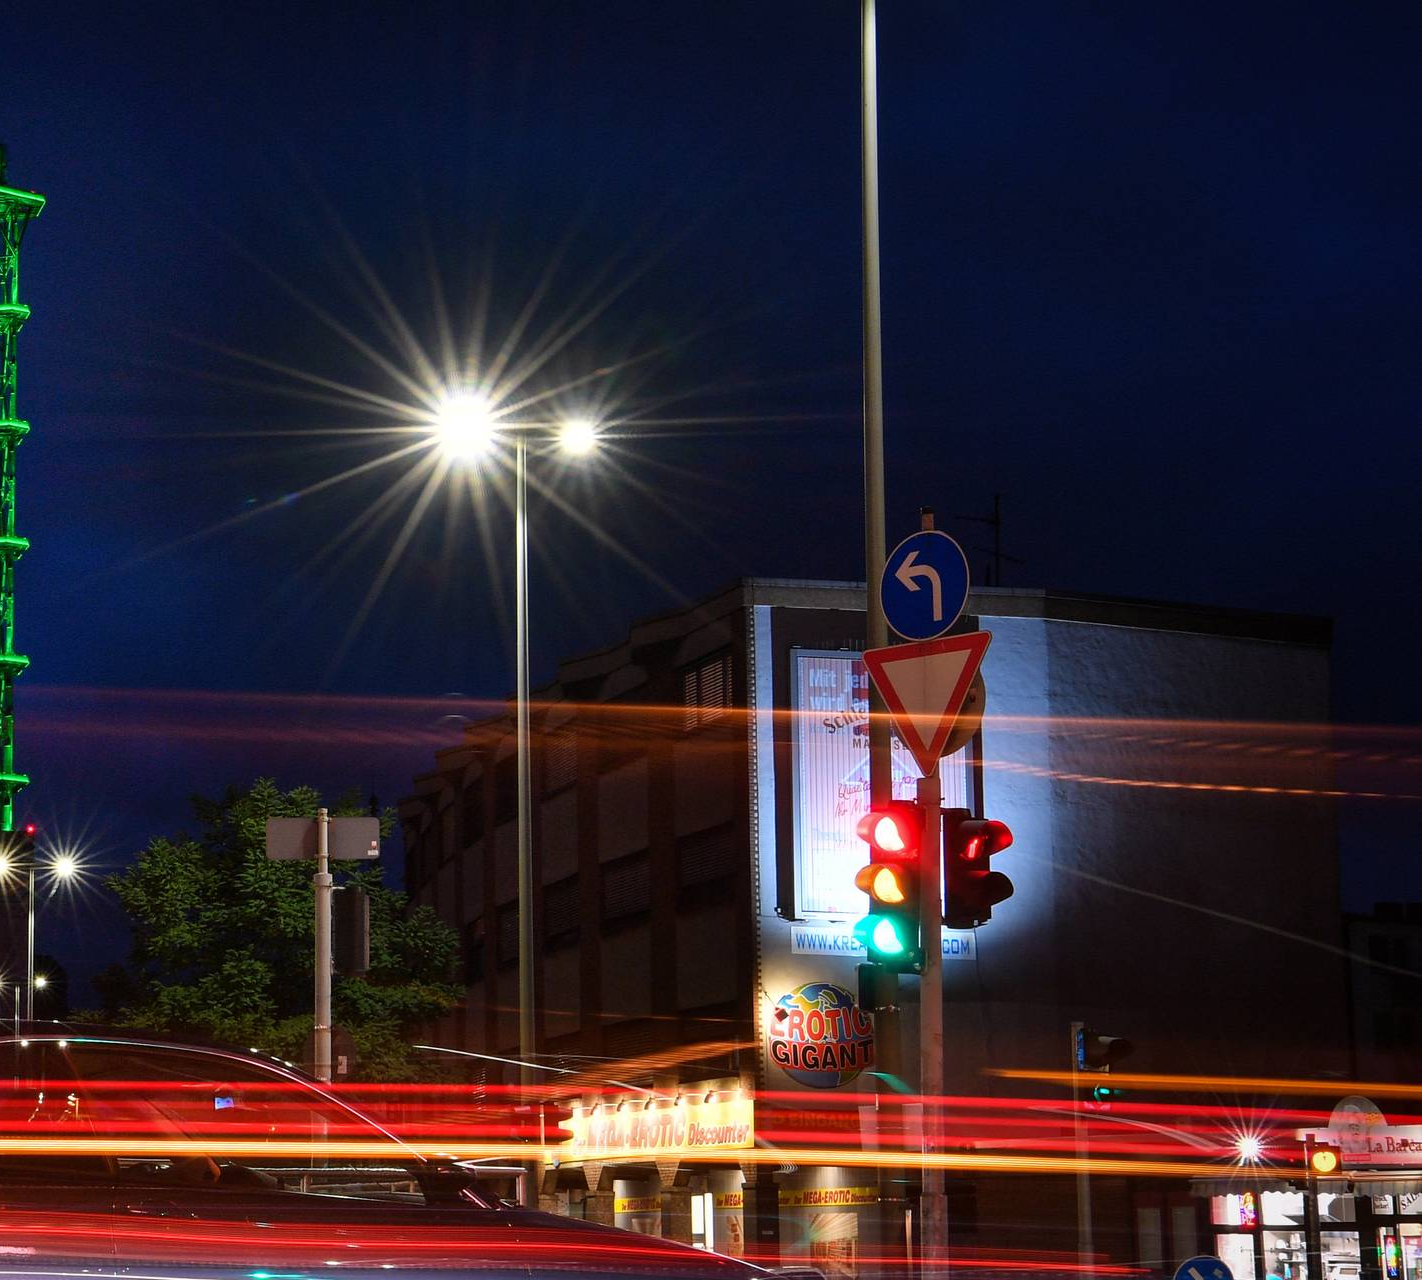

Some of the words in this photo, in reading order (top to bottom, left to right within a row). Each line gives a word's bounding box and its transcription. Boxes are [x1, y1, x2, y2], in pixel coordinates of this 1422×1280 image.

[810, 669, 836, 688] Mit
[844, 670, 869, 692] jed
[770, 1008, 873, 1041] EROTIC
[771, 1040, 872, 1069] GIGANT
[687, 1121, 751, 1147] Discounter
[1366, 1137, 1381, 1153] La
[802, 1190, 850, 1205] MEGA-EROTIC
